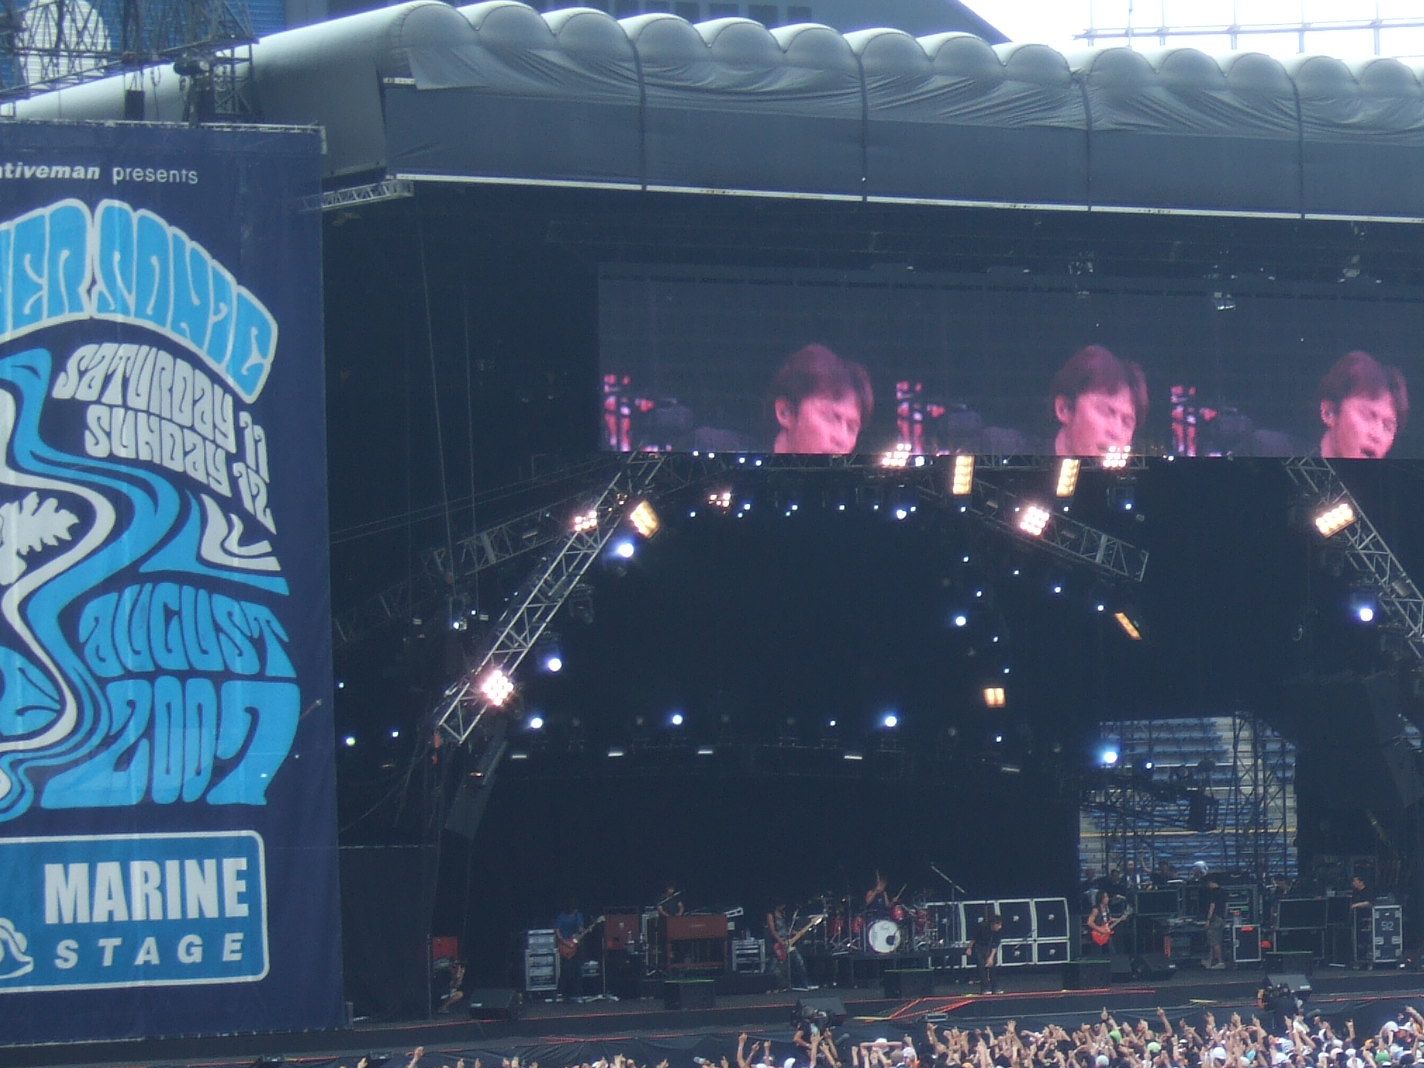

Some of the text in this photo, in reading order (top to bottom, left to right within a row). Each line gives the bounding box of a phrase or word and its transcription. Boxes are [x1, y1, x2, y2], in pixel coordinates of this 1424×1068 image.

[112, 164, 198, 184] presents
[52, 343, 237, 453] SATURDAY
[84, 404, 232, 498] SUNDAY
[79, 582, 296, 678] AUGUST
[41, 676, 301, 810] 2007
[44, 857, 249, 925] MARINE
[54, 932, 244, 970] STAGE
